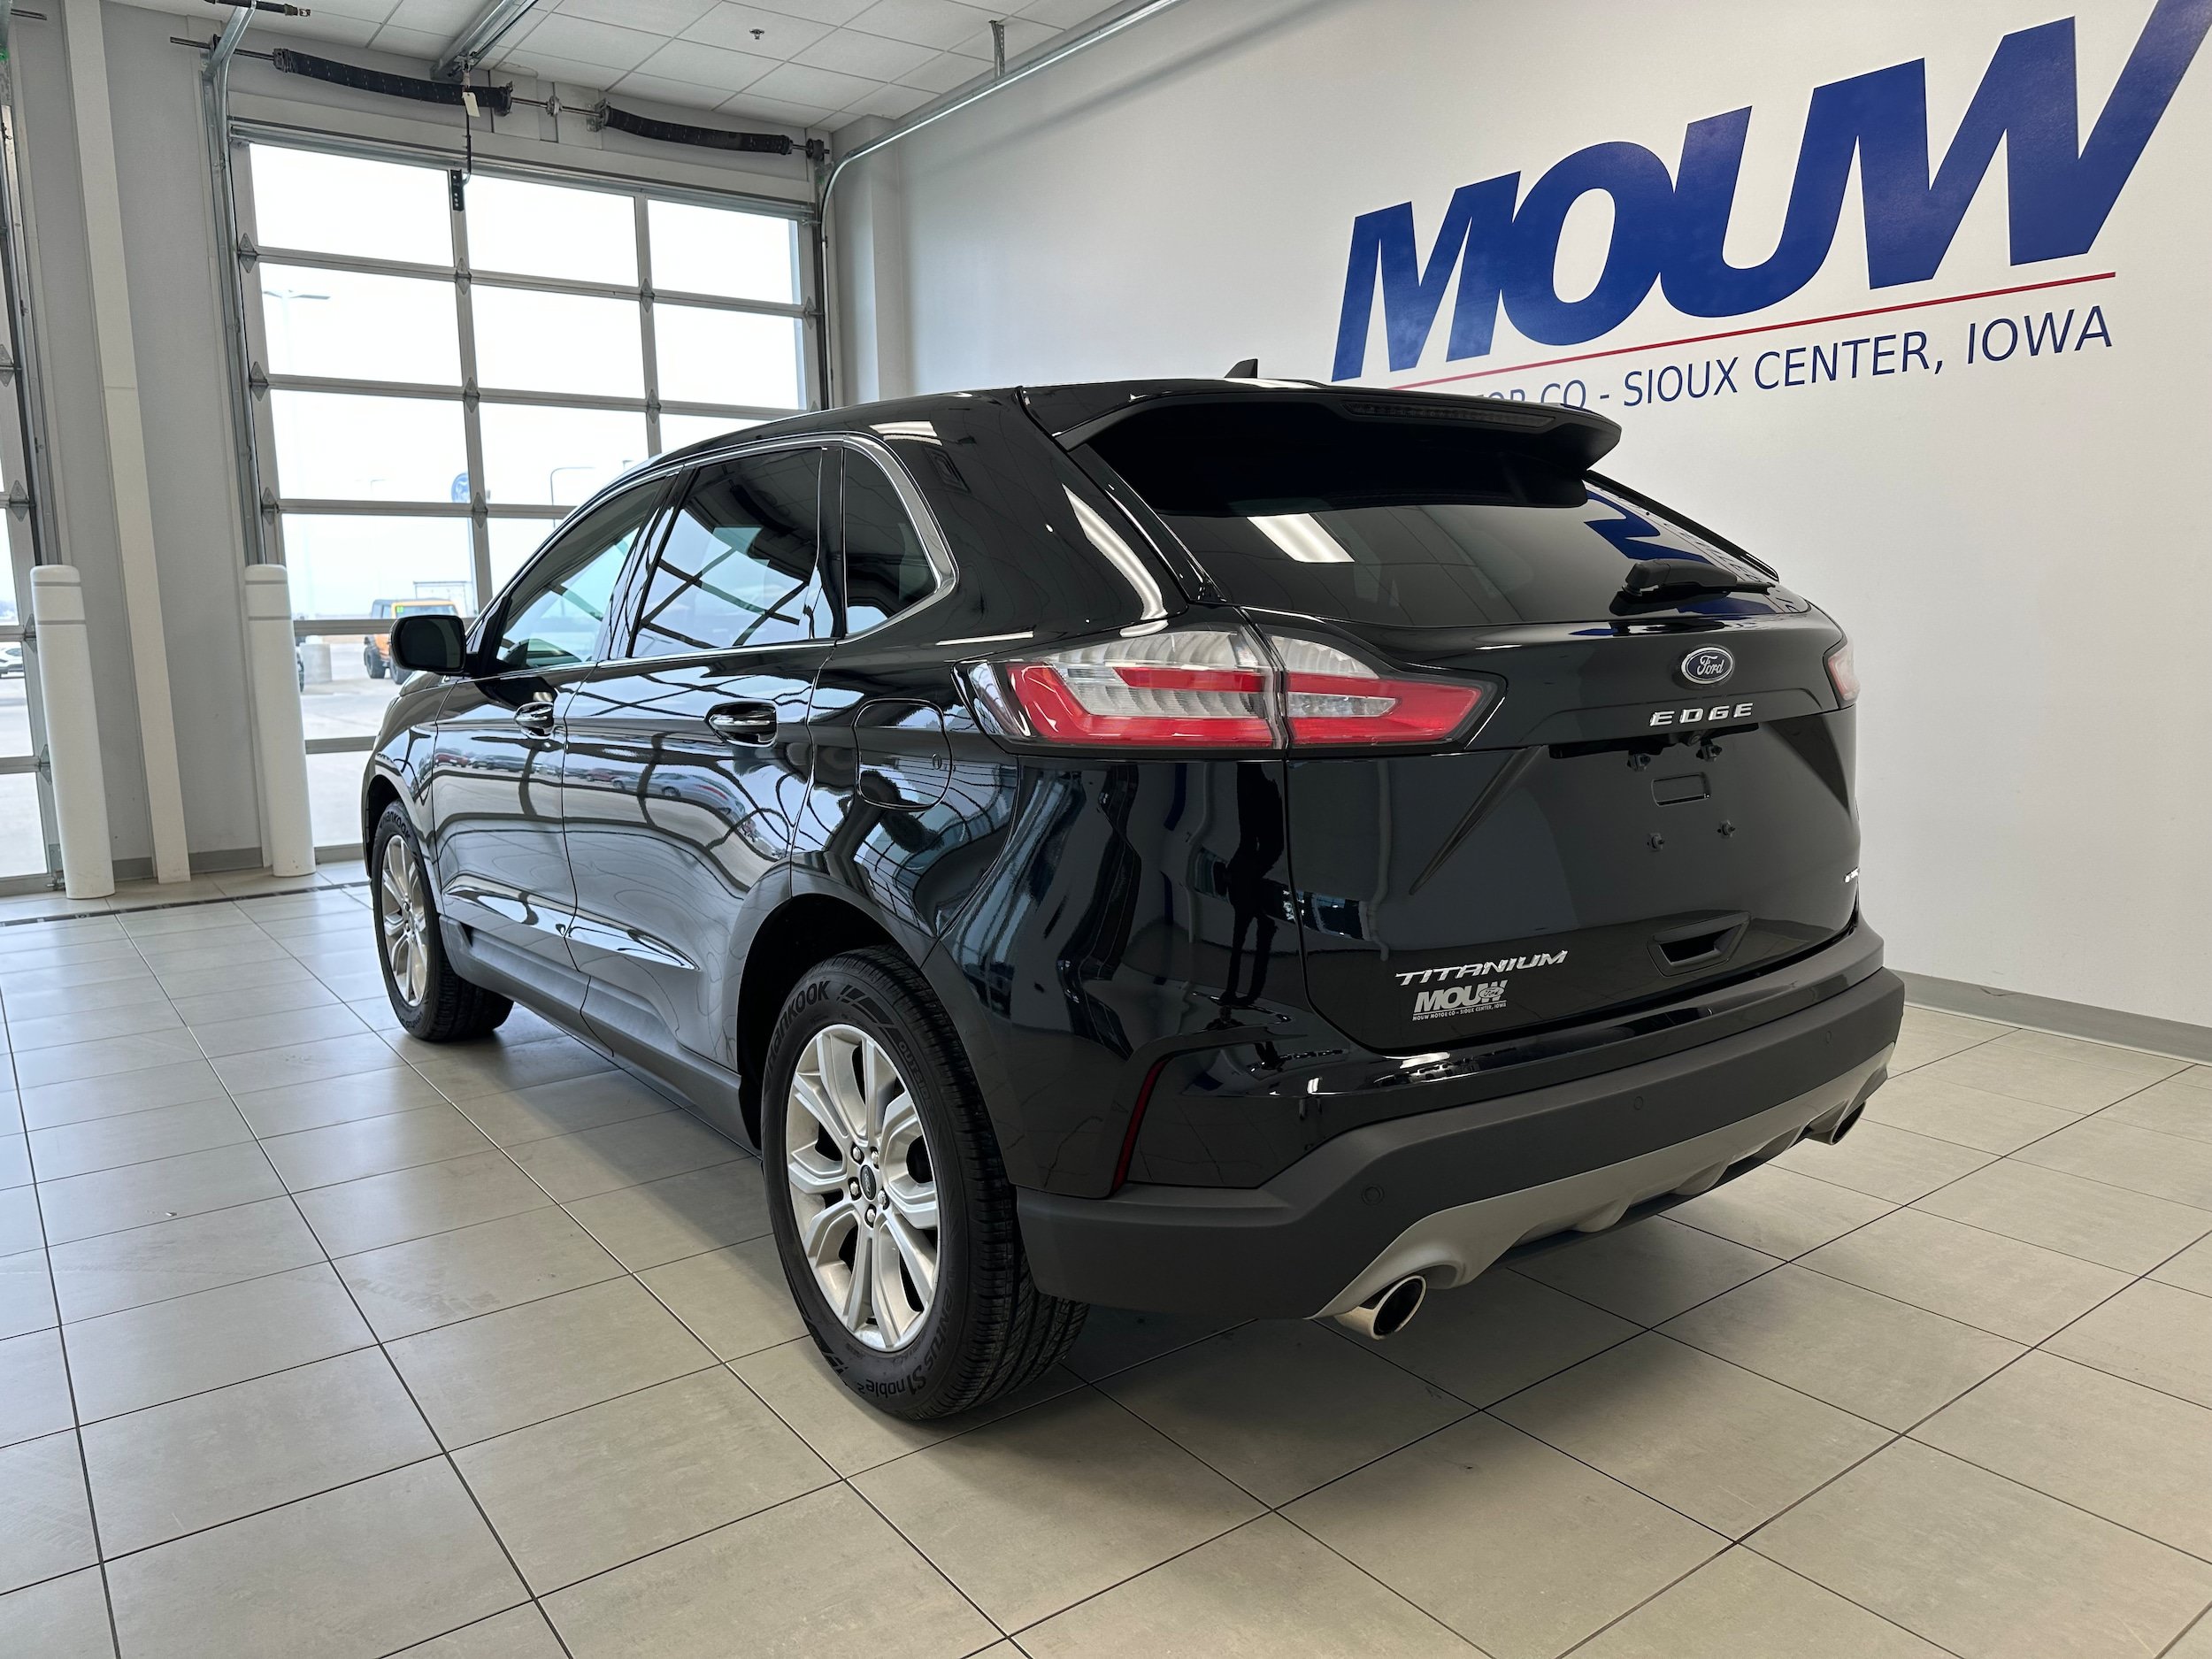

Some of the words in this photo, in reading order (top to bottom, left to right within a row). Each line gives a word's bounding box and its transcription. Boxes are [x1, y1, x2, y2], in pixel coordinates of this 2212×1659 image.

[1332, 0, 2212, 382] MOUW
[1540, 380, 1586, 409] CO
[1624, 357, 1739, 407] SIOUX
[1754, 330, 1944, 389] CENTER,
[1968, 305, 2113, 365] IOWA
[1697, 655, 1724, 675] Ford
[1650, 703, 1753, 726] EDGE
[1394, 949, 1569, 986] TITANIUM
